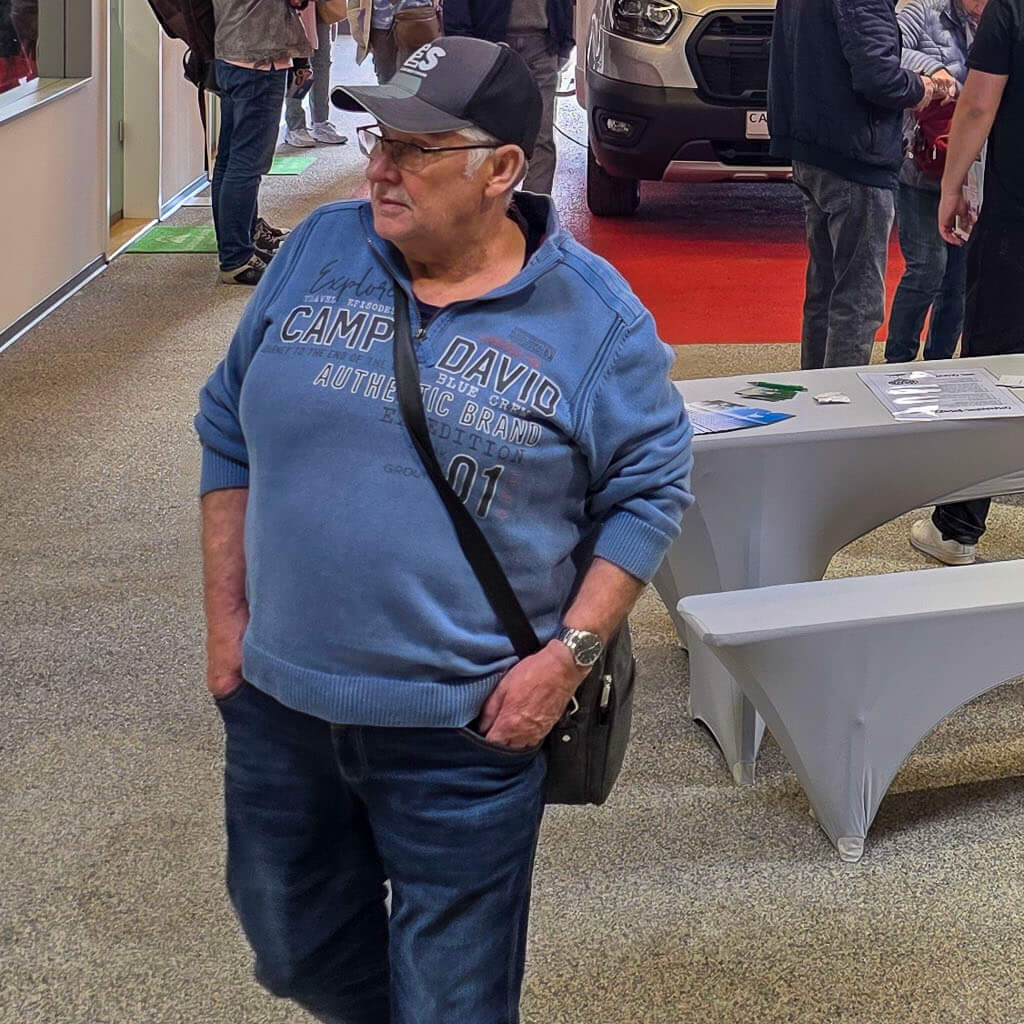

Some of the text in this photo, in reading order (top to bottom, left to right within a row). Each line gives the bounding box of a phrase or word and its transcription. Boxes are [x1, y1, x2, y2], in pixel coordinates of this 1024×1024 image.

[280, 305, 395, 353] CAMP
[434, 335, 562, 417] DAVID
[436, 373, 479, 398] BLUE
[459, 400, 543, 447] BRAND
[447, 453, 505, 520] 01
